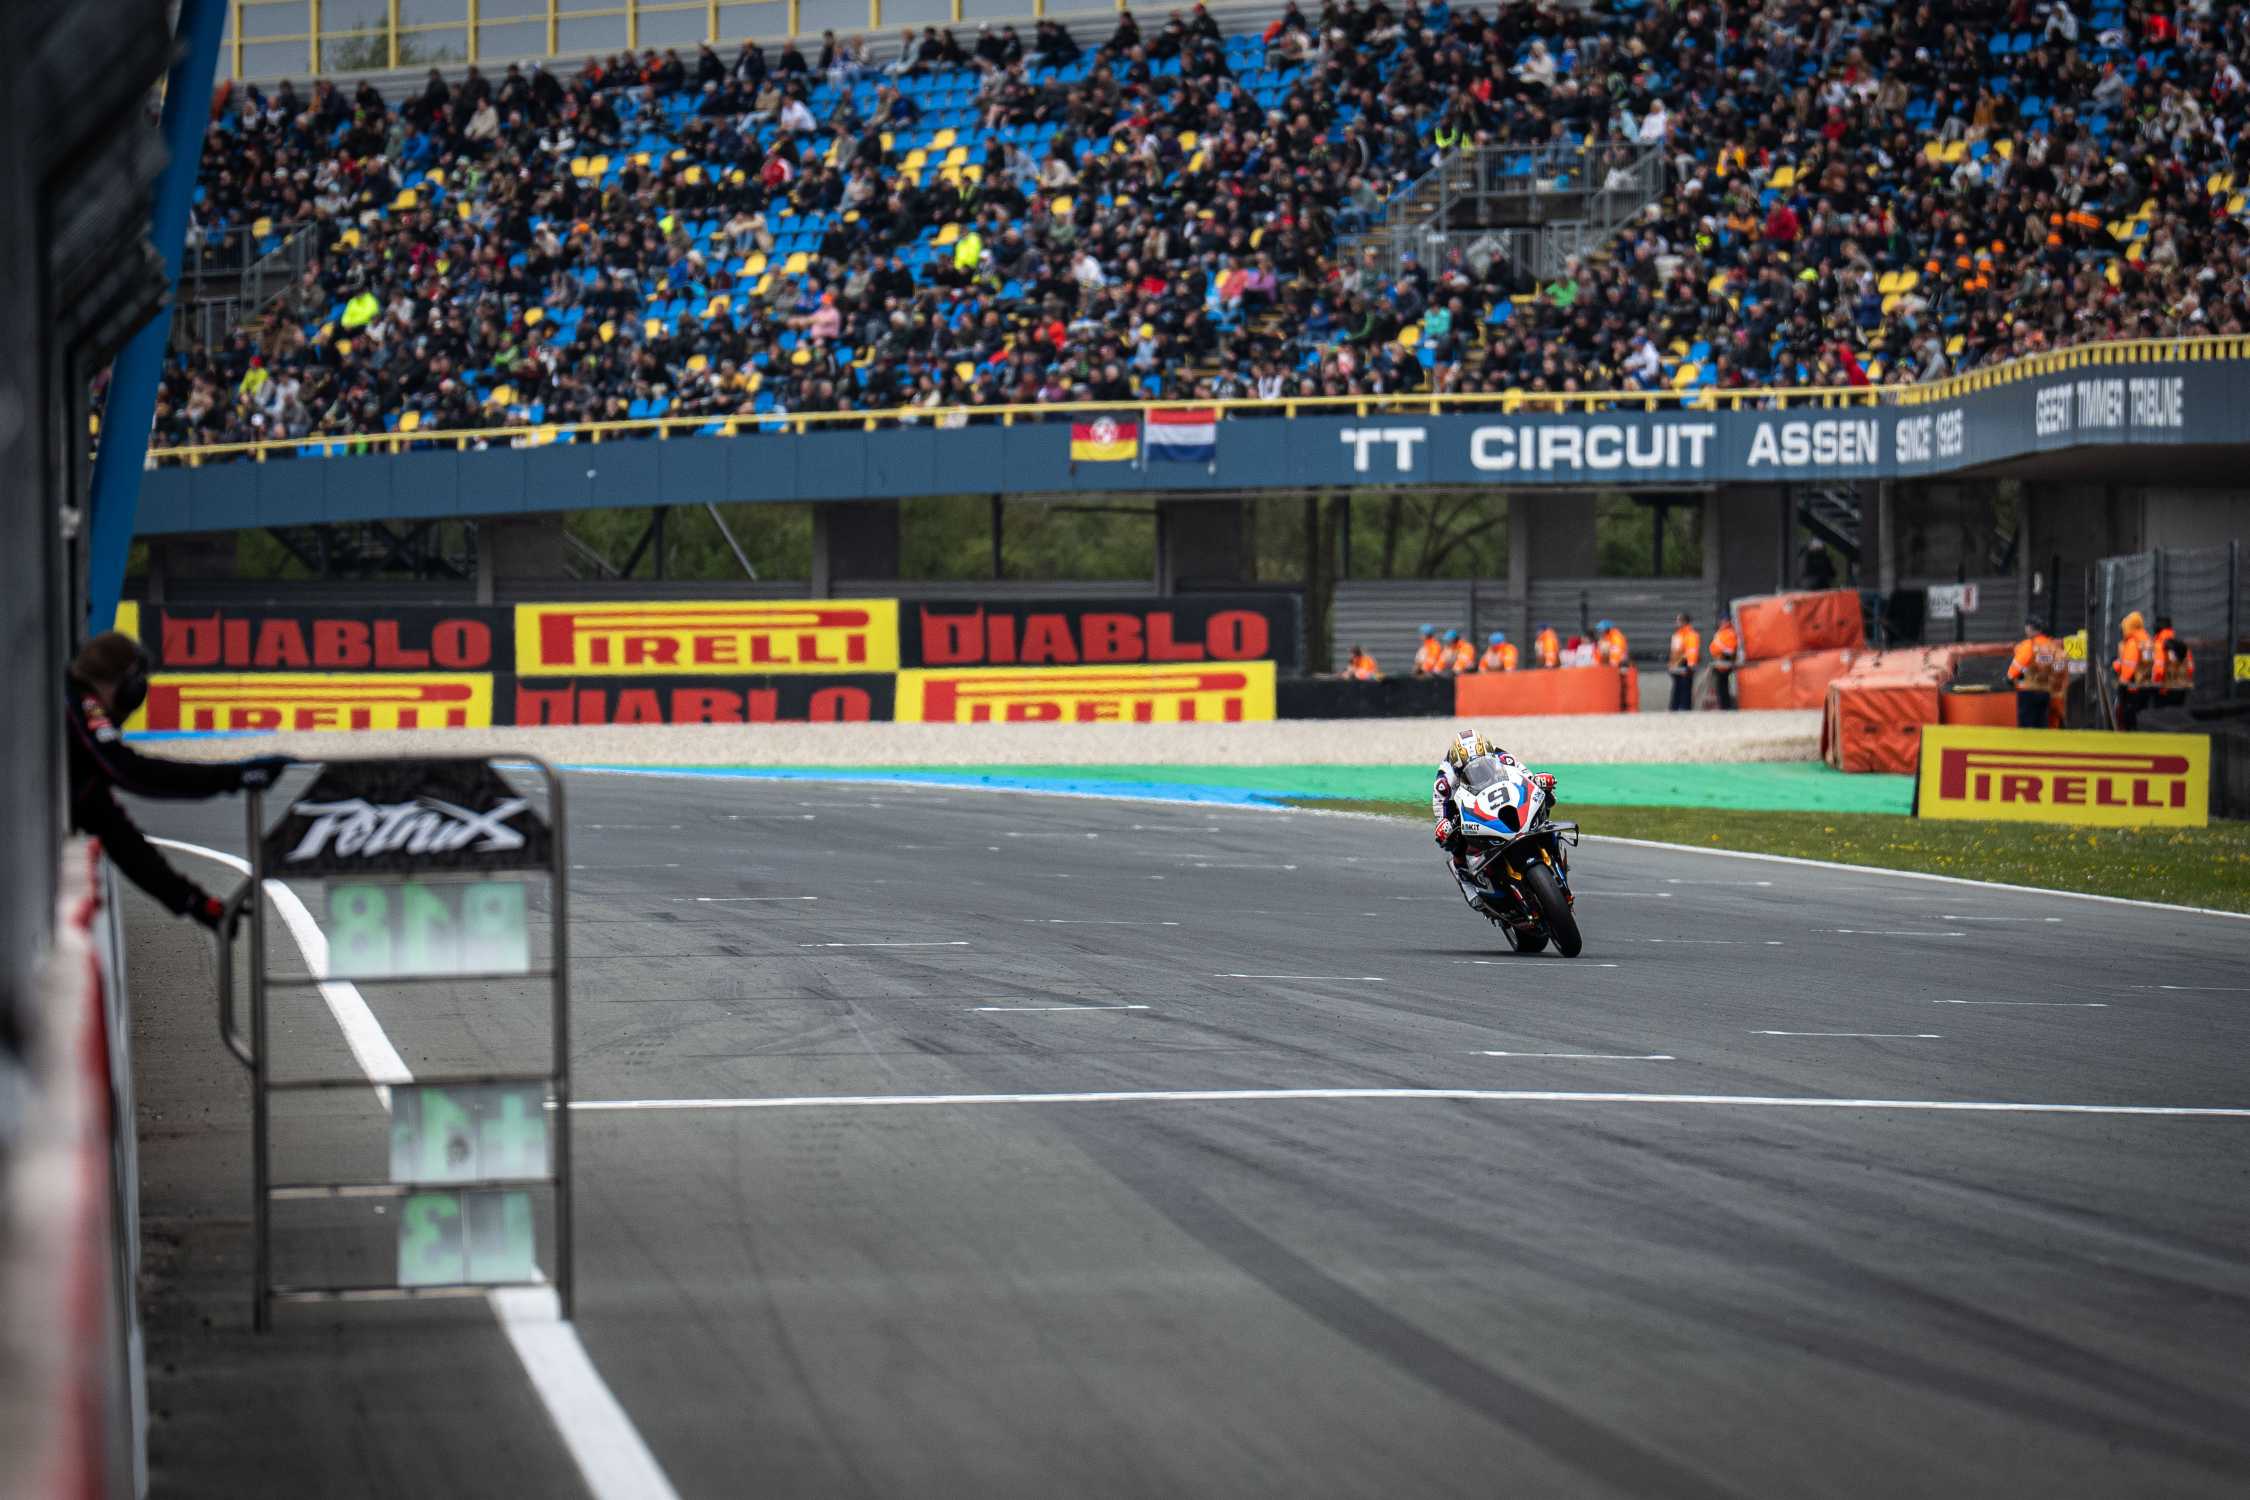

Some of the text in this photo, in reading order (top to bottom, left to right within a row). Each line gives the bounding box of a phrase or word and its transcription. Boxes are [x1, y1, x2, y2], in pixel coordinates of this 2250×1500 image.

[2036, 376, 2184, 437] GEERT TIMMER TRIBUNE
[1340, 408, 1964, 472] TT CIRCUIT ASSEN SINCE 1925
[162, 608, 492, 669] DIABLO
[539, 609, 870, 666] PIRELLI
[920, 602, 1269, 664] DIABLO
[1487, 786, 1510, 803] 9
[1940, 747, 2189, 808] PIRELLI
